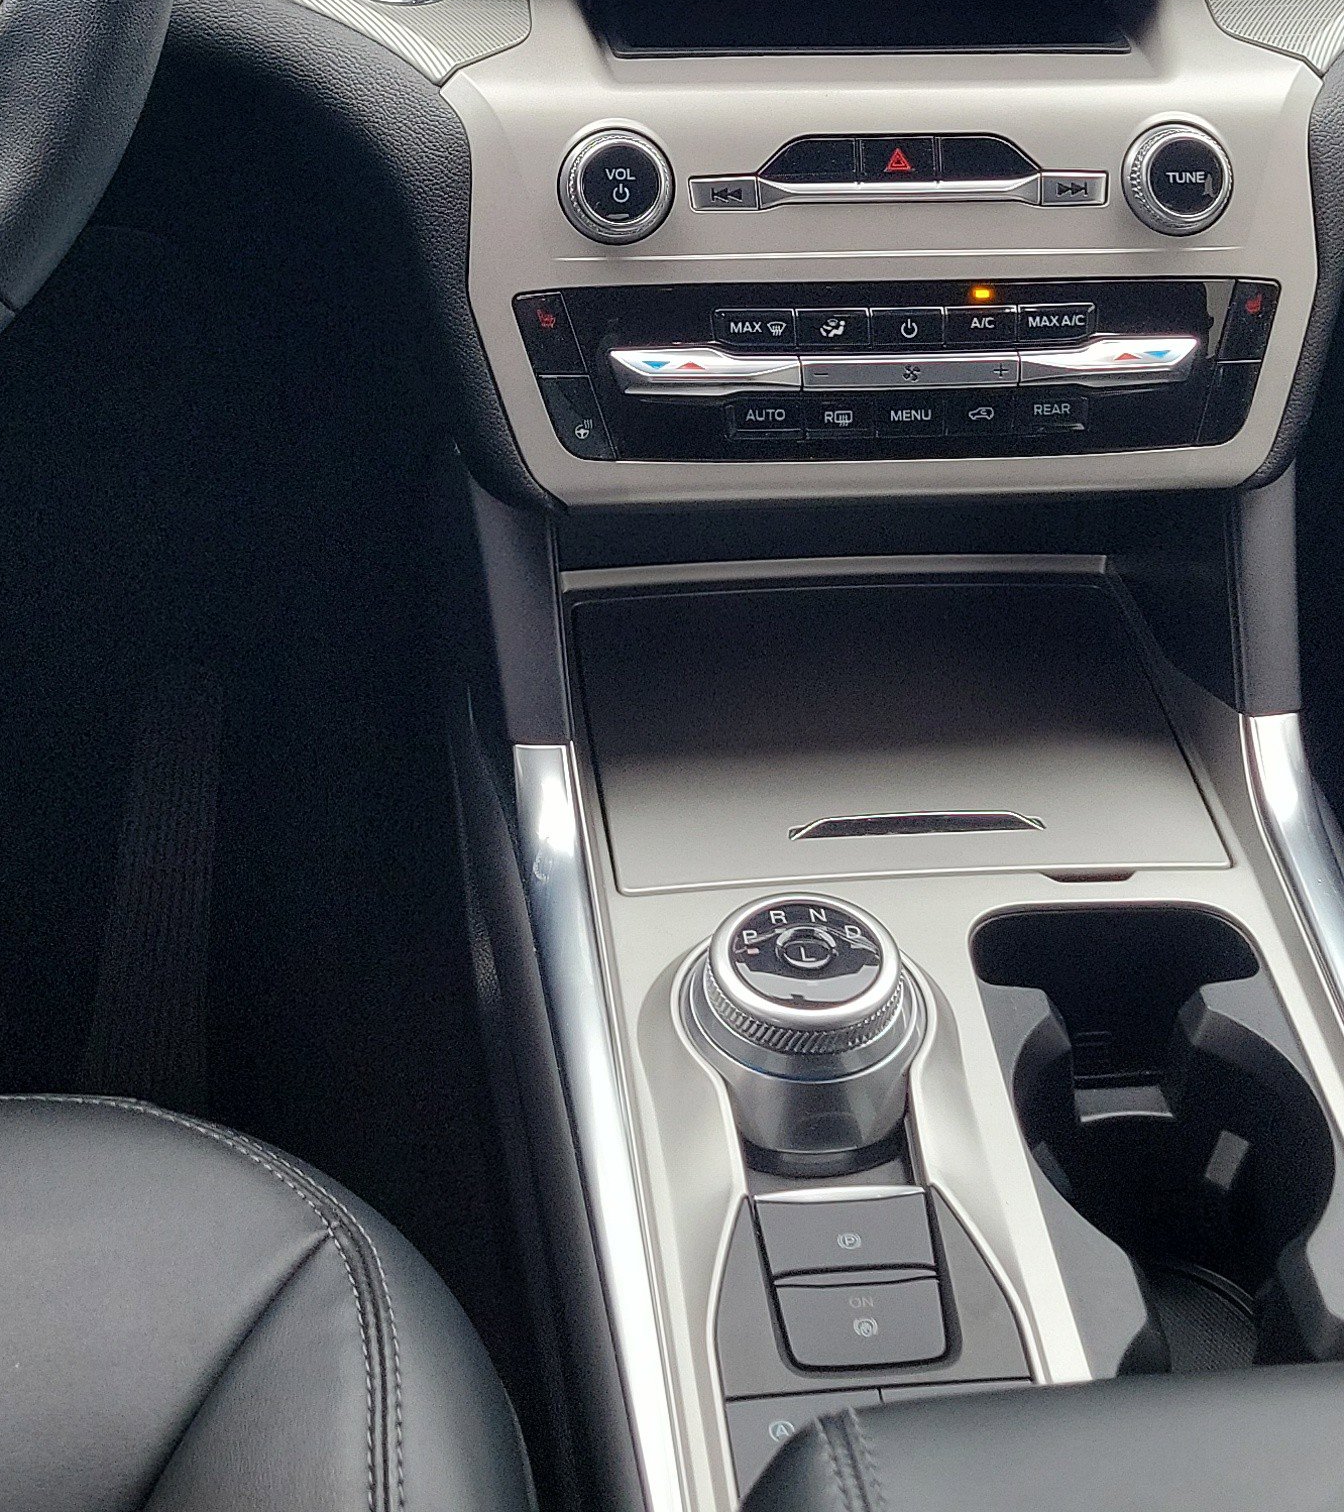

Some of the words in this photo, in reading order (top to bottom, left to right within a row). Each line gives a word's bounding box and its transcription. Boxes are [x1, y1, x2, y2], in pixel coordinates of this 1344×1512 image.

[604, 168, 636, 180] VOL
[1165, 171, 1206, 184] TUNE
[970, 316, 995, 329] A/C
[1028, 314, 1060, 328] MAX
[1060, 313, 1085, 327] A/C
[729, 322, 762, 334] MAX
[745, 408, 786, 421] AUTO
[890, 409, 932, 422] MENU
[1033, 403, 1071, 416] REAR
[769, 910, 787, 924] R
[809, 908, 827, 923] N
[742, 929, 758, 944] P
[844, 925, 862, 939] D
